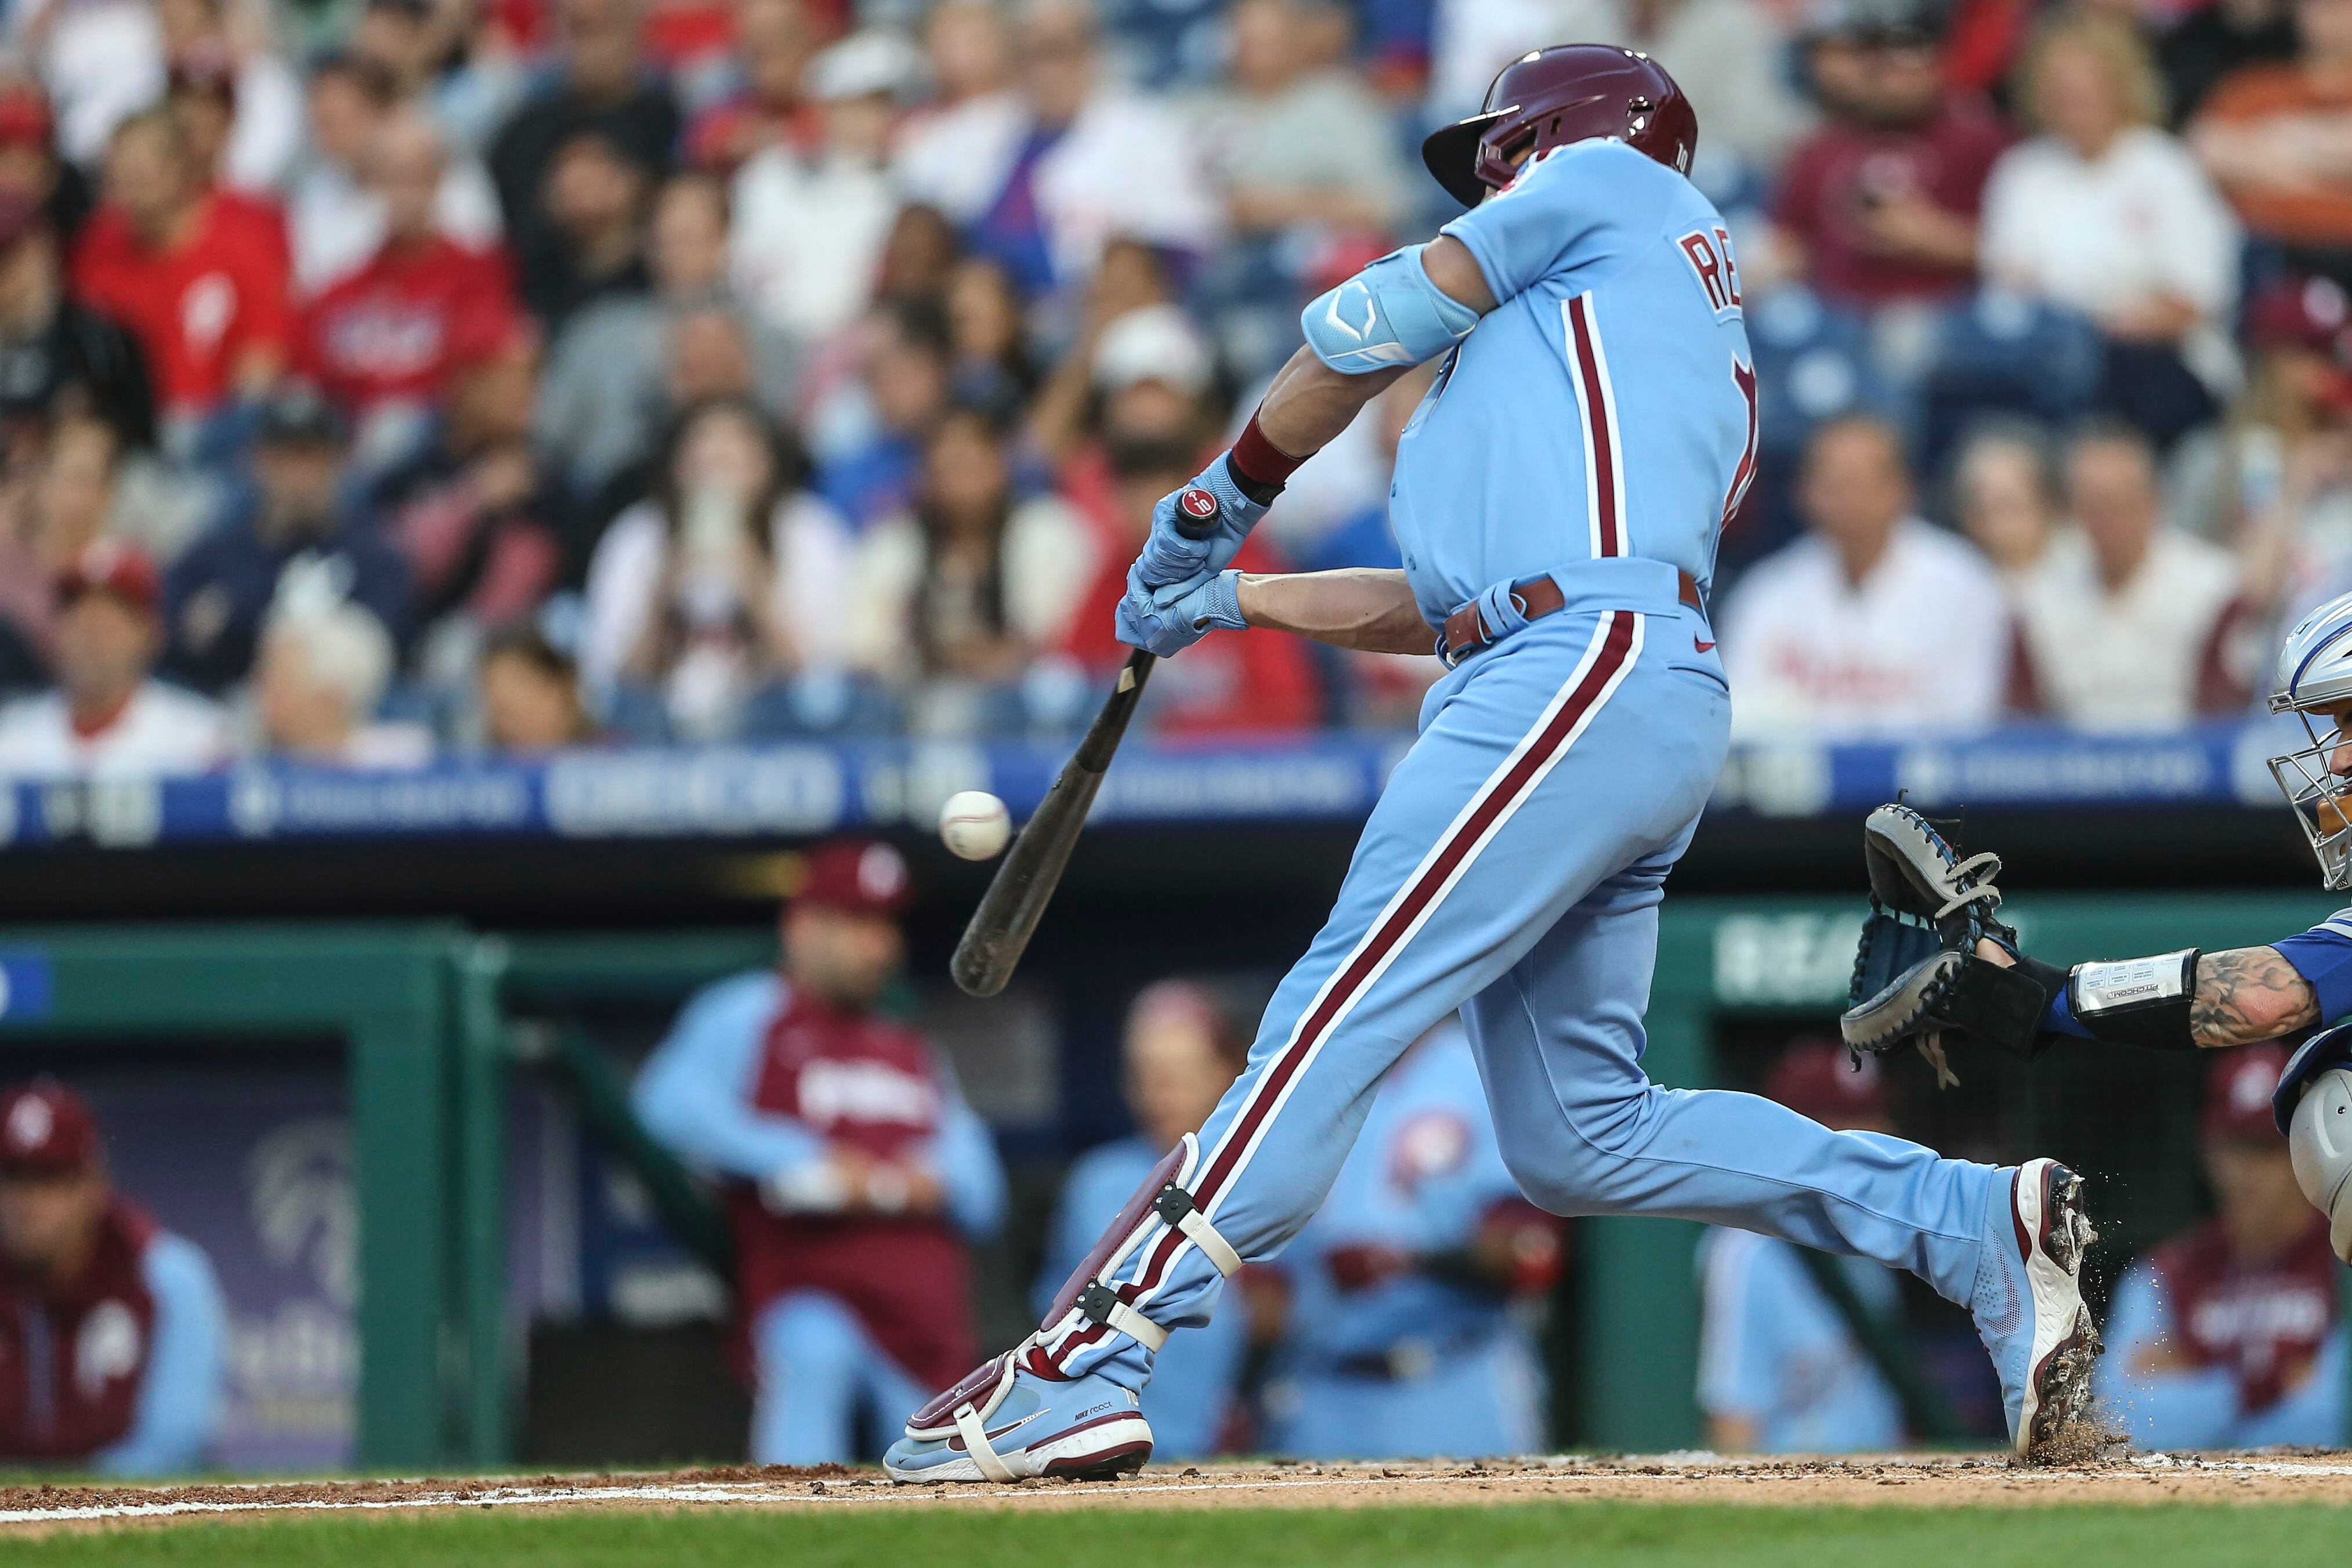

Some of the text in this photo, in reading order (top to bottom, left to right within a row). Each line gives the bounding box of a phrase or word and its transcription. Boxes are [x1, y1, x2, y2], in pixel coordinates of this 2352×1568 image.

[1194, 499, 1212, 513] 10
[2114, 984, 2158, 997] PITCHCOM
[1075, 1410, 1088, 1421] NIKE
